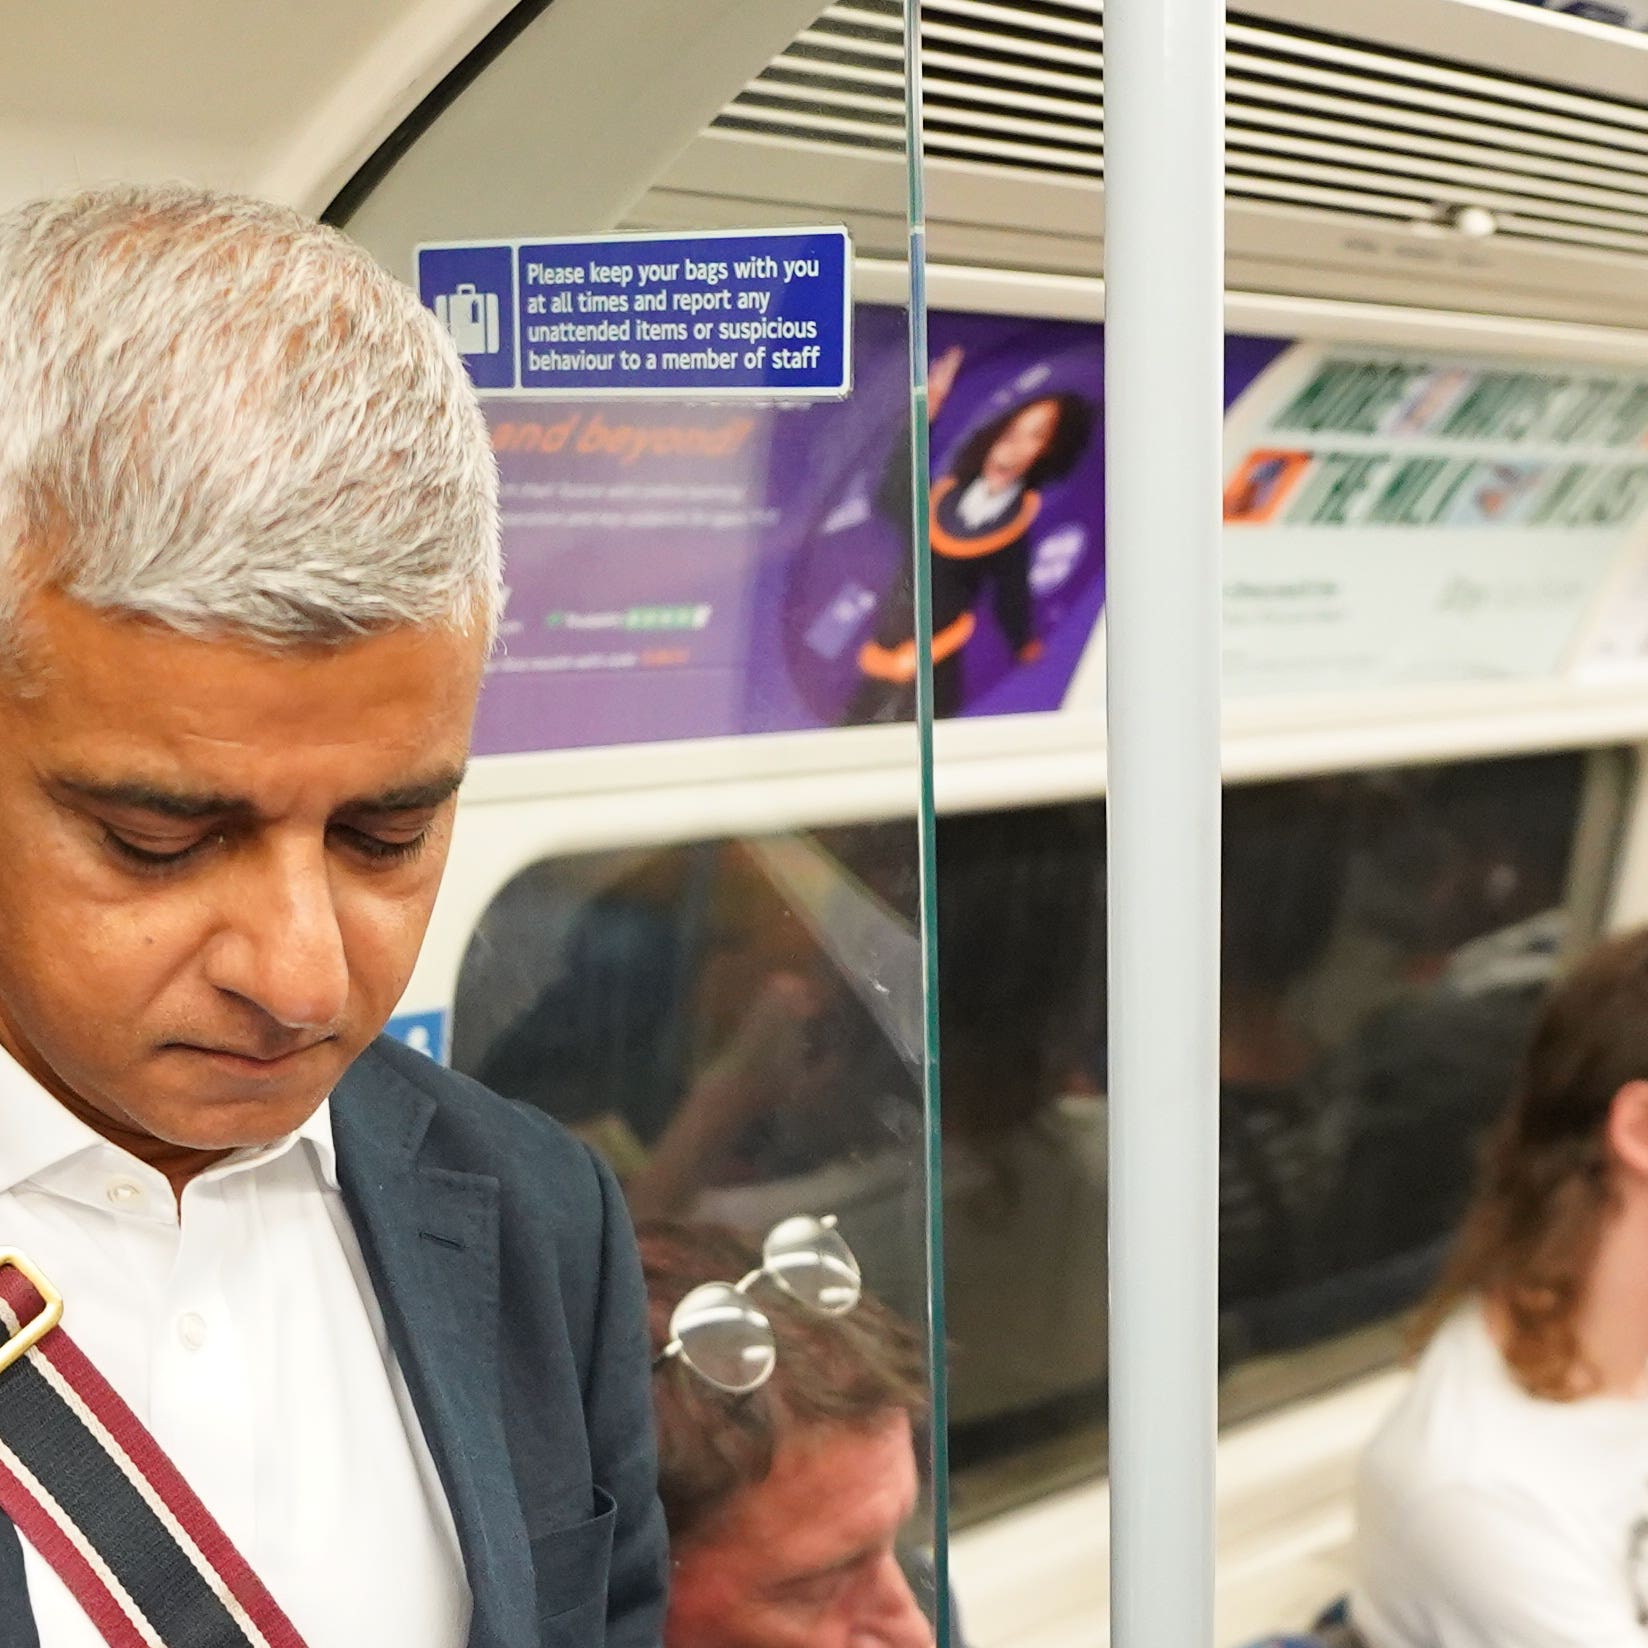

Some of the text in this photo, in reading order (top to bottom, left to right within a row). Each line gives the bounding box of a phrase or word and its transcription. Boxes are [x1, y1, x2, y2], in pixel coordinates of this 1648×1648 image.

[527, 256, 820, 287] Please keep your bags with you
[527, 289, 770, 314] at all times and report any
[528, 318, 817, 344] unattended items or suspicious
[528, 346, 820, 371] behaviour to a member of staff
